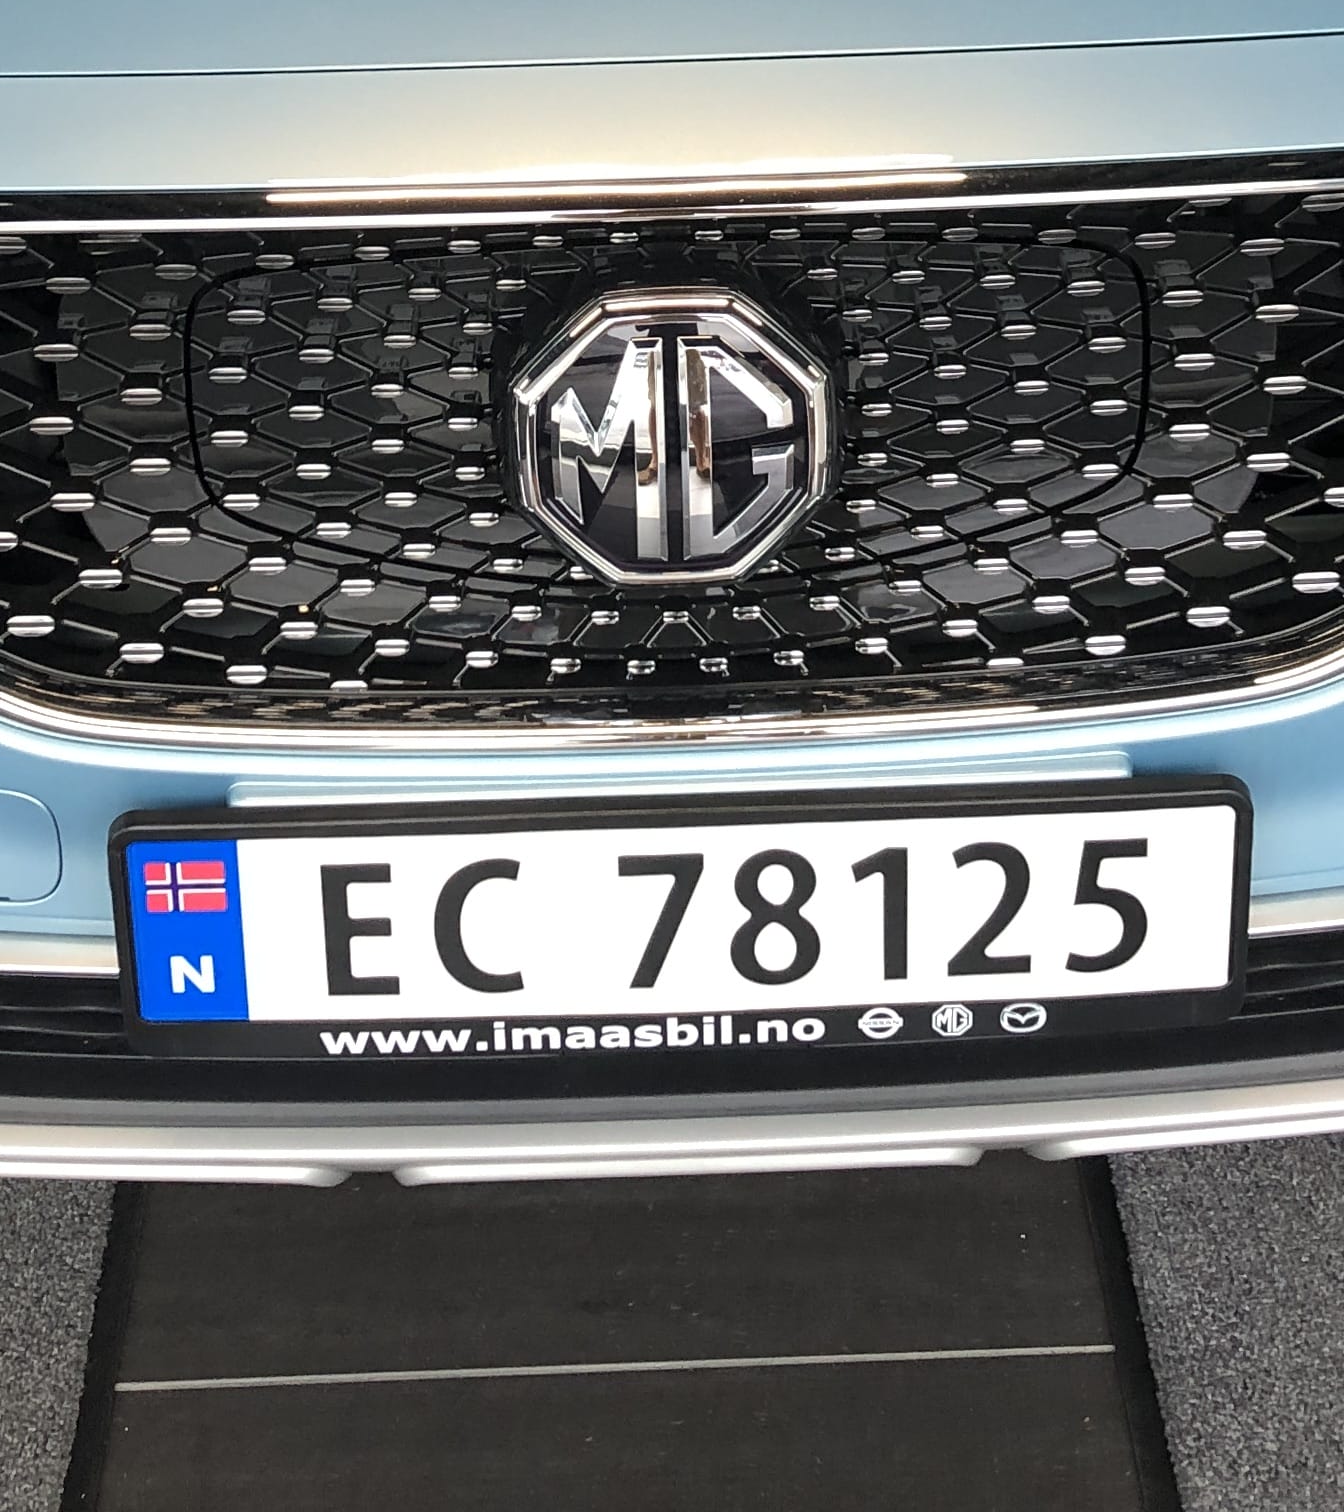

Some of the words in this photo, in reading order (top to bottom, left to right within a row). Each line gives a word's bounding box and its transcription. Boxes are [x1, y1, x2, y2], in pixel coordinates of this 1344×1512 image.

[550, 335, 795, 562] MG
[320, 857, 524, 996] EC
[618, 837, 1149, 989] 78125
[170, 954, 216, 994] N
[319, 1015, 826, 1055] www.imaasbil.no
